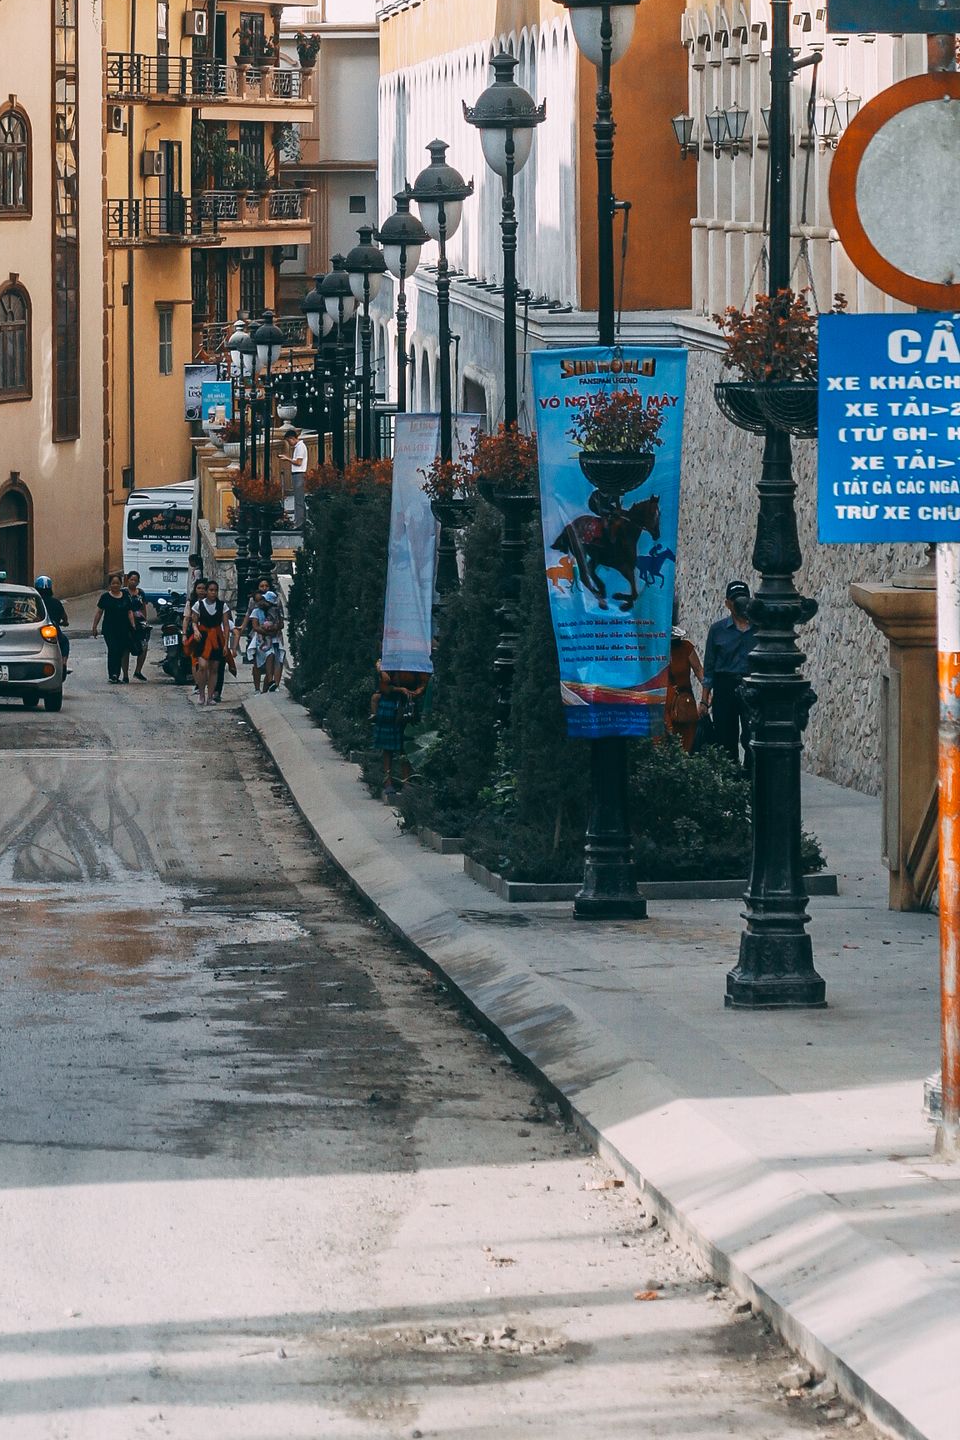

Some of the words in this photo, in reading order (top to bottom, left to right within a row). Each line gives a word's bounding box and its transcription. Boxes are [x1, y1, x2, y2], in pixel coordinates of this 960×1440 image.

[826, 376, 860, 391] XE
[647, 393, 679, 408] MÂY
[845, 403, 879, 417] XE
[851, 456, 885, 470] XE
[894, 448, 960, 470] TẢI>
[872, 474, 892, 495] CẢ
[896, 476, 926, 495] CÁC
[835, 501, 880, 520] TRỪ
[883, 506, 910, 520] XE
